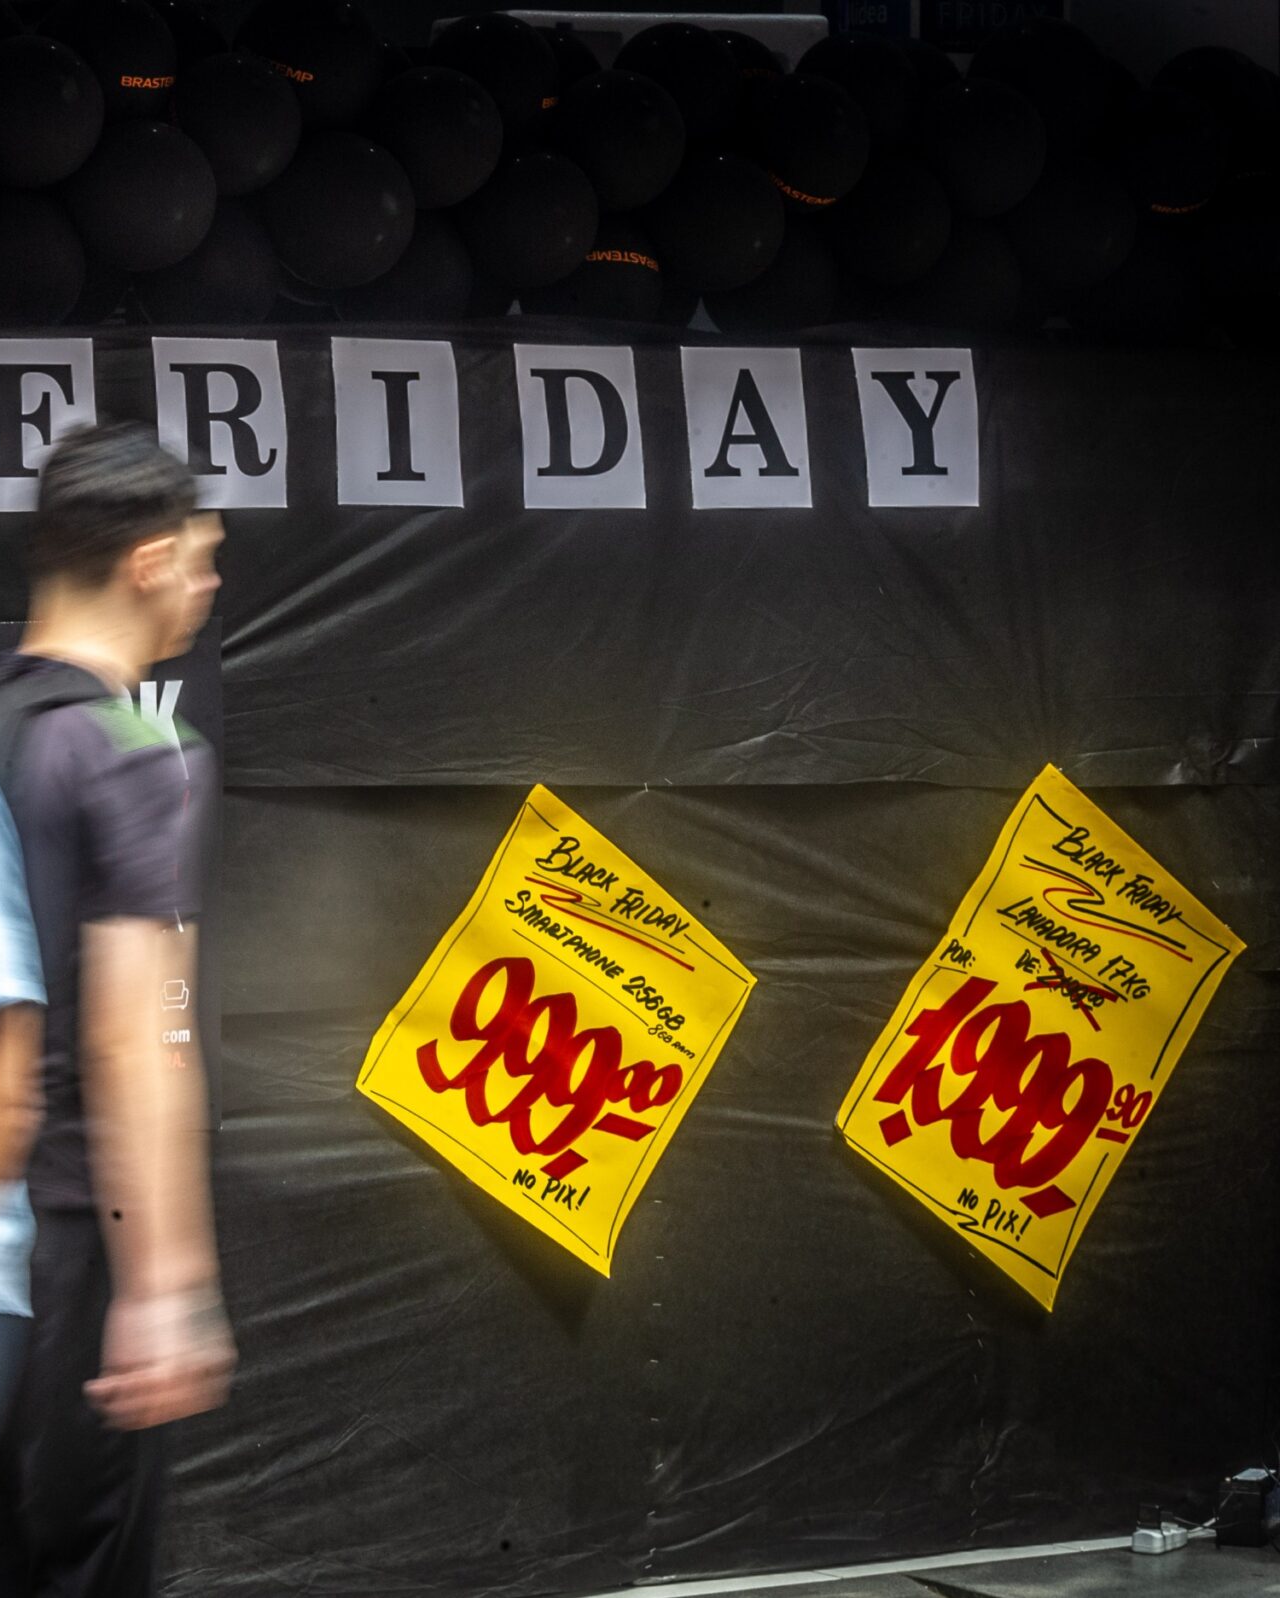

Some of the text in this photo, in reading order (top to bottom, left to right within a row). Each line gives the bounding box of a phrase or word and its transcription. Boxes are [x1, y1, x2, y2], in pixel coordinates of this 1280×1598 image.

[535, 836, 690, 938] BLACK FRIDAY
[1052, 827, 1183, 924] BLACK FRIDAY
[505, 890, 625, 979] SMARTPHONE
[939, 939, 976, 967] POR:
[997, 896, 1102, 964] LAVADORA
[513, 1168, 590, 1211] NO PIX!
[958, 1188, 1032, 1241] NO PIX!
